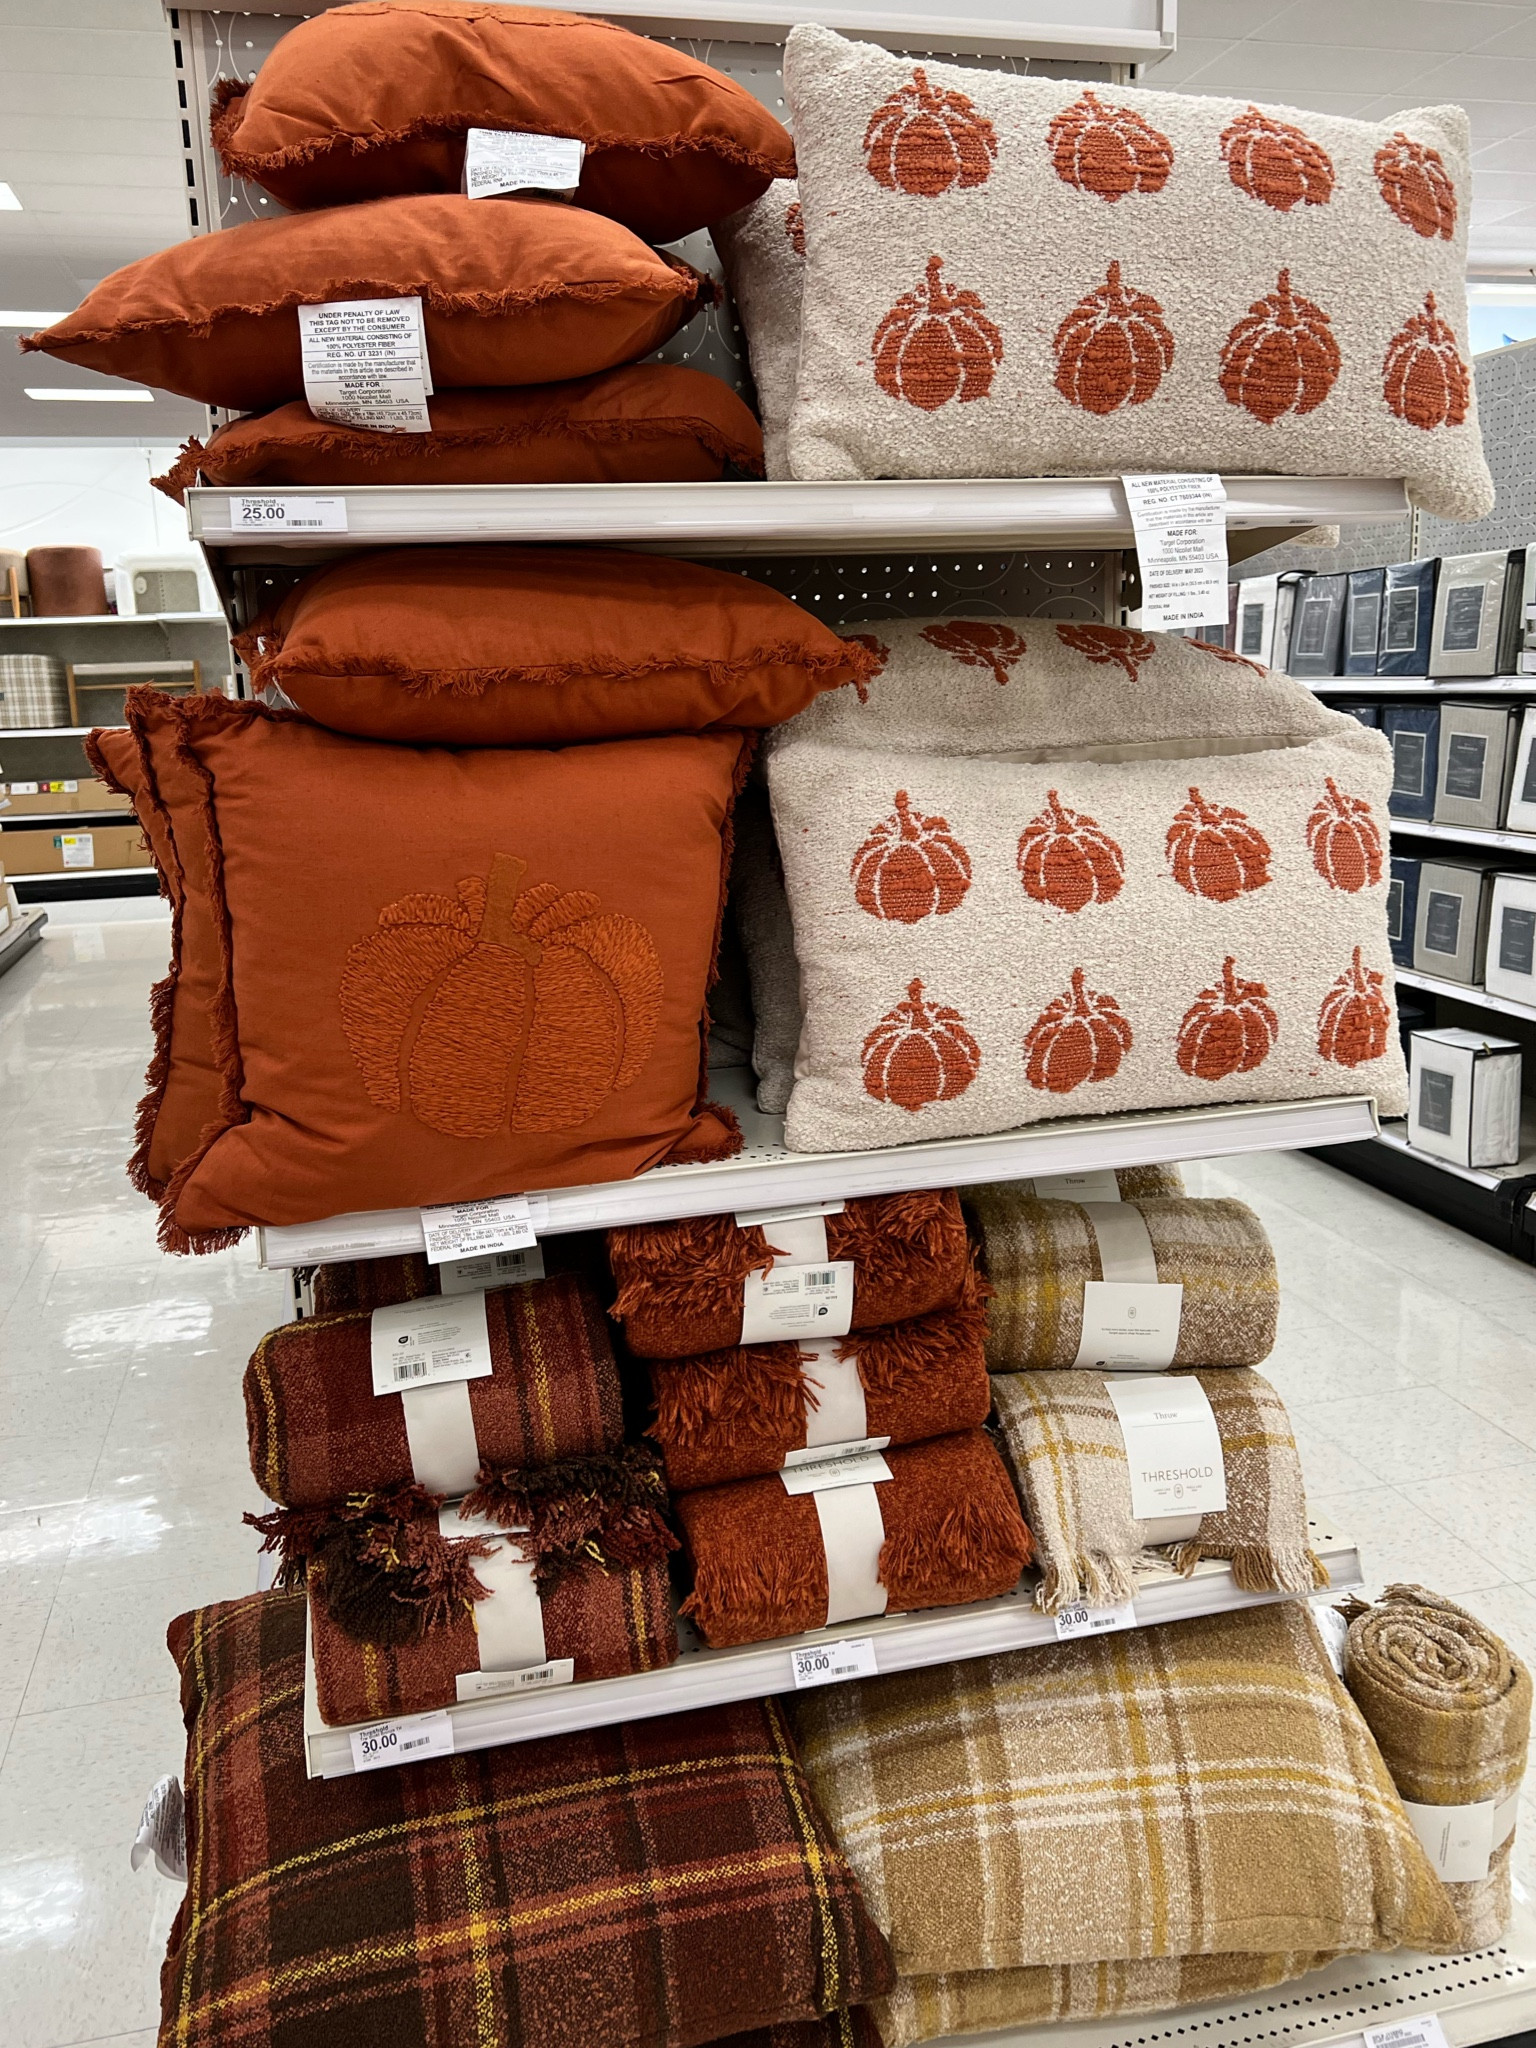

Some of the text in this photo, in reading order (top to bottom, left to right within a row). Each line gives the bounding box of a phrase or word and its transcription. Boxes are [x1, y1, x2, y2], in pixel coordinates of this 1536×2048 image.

[242, 508, 285, 519] 25.00
[1177, 538, 1205, 546] Corporation
[449, 1228, 471, 1236] DELIVERY
[793, 1455, 869, 1473] THRESHOLD
[1141, 1467, 1213, 1482] THRESHOLD
[1059, 1611, 1088, 1625] 30.00
[798, 1657, 829, 1673] 30.00
[360, 1725, 388, 1739] Threshold
[362, 1733, 397, 1754] 30.00
